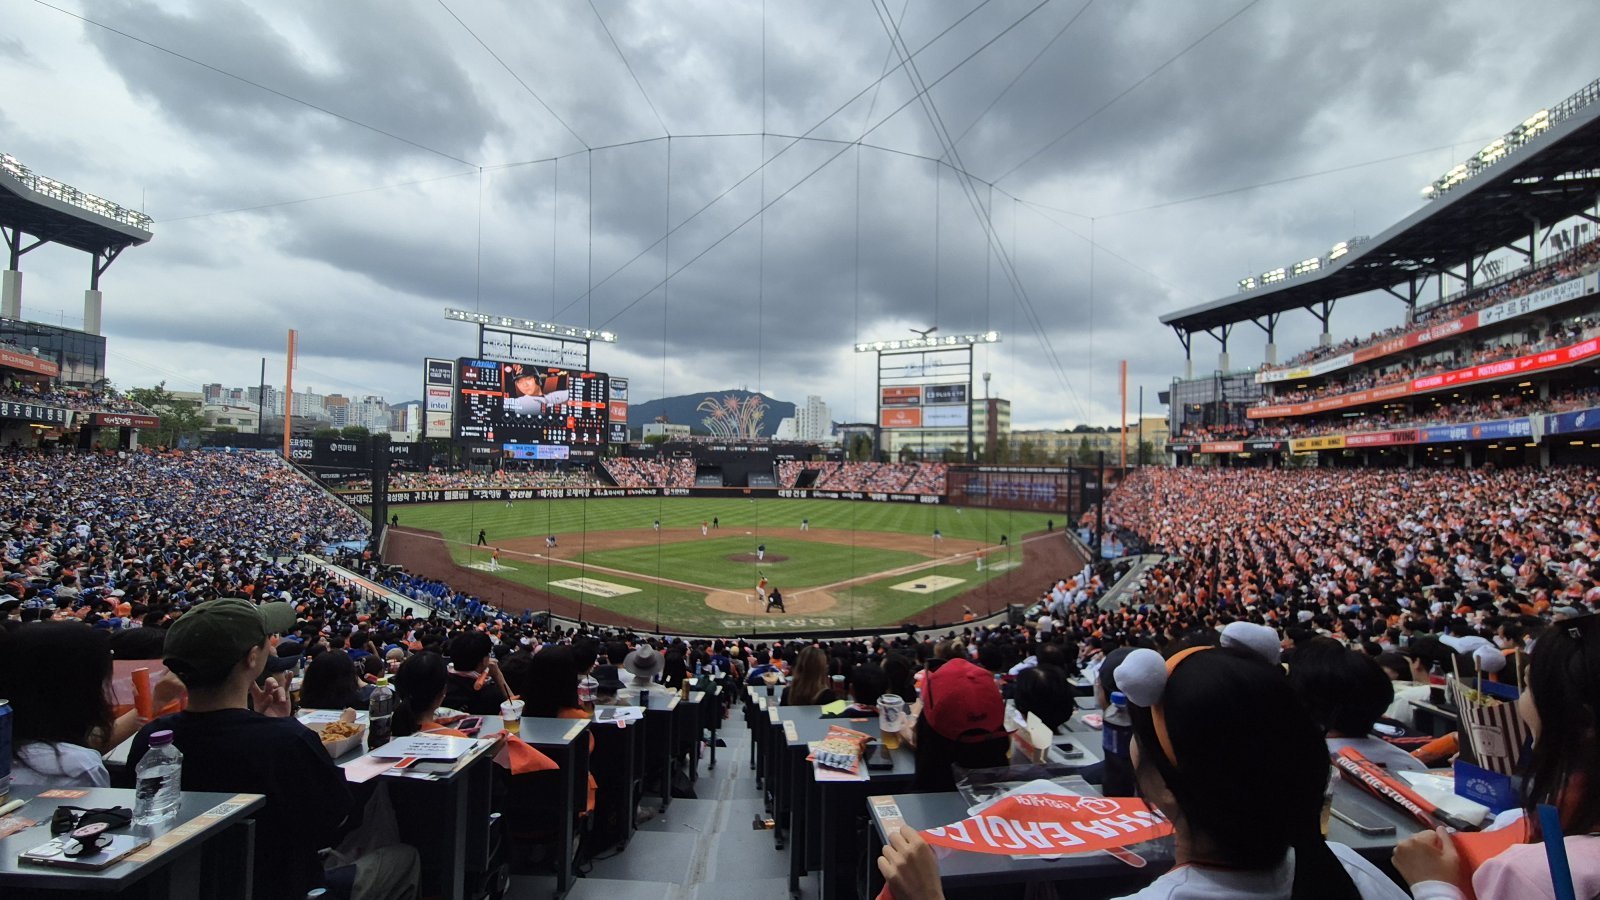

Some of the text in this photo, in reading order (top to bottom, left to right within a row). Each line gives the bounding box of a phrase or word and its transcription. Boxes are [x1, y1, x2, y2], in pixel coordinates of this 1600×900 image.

[1392, 430, 1416, 443] TVING
[290, 438, 313, 447] 도표성경김
[292, 450, 313, 459] GS25
[778, 490, 806, 498] 대방건설
[1380, 786, 1422, 814] STORM
